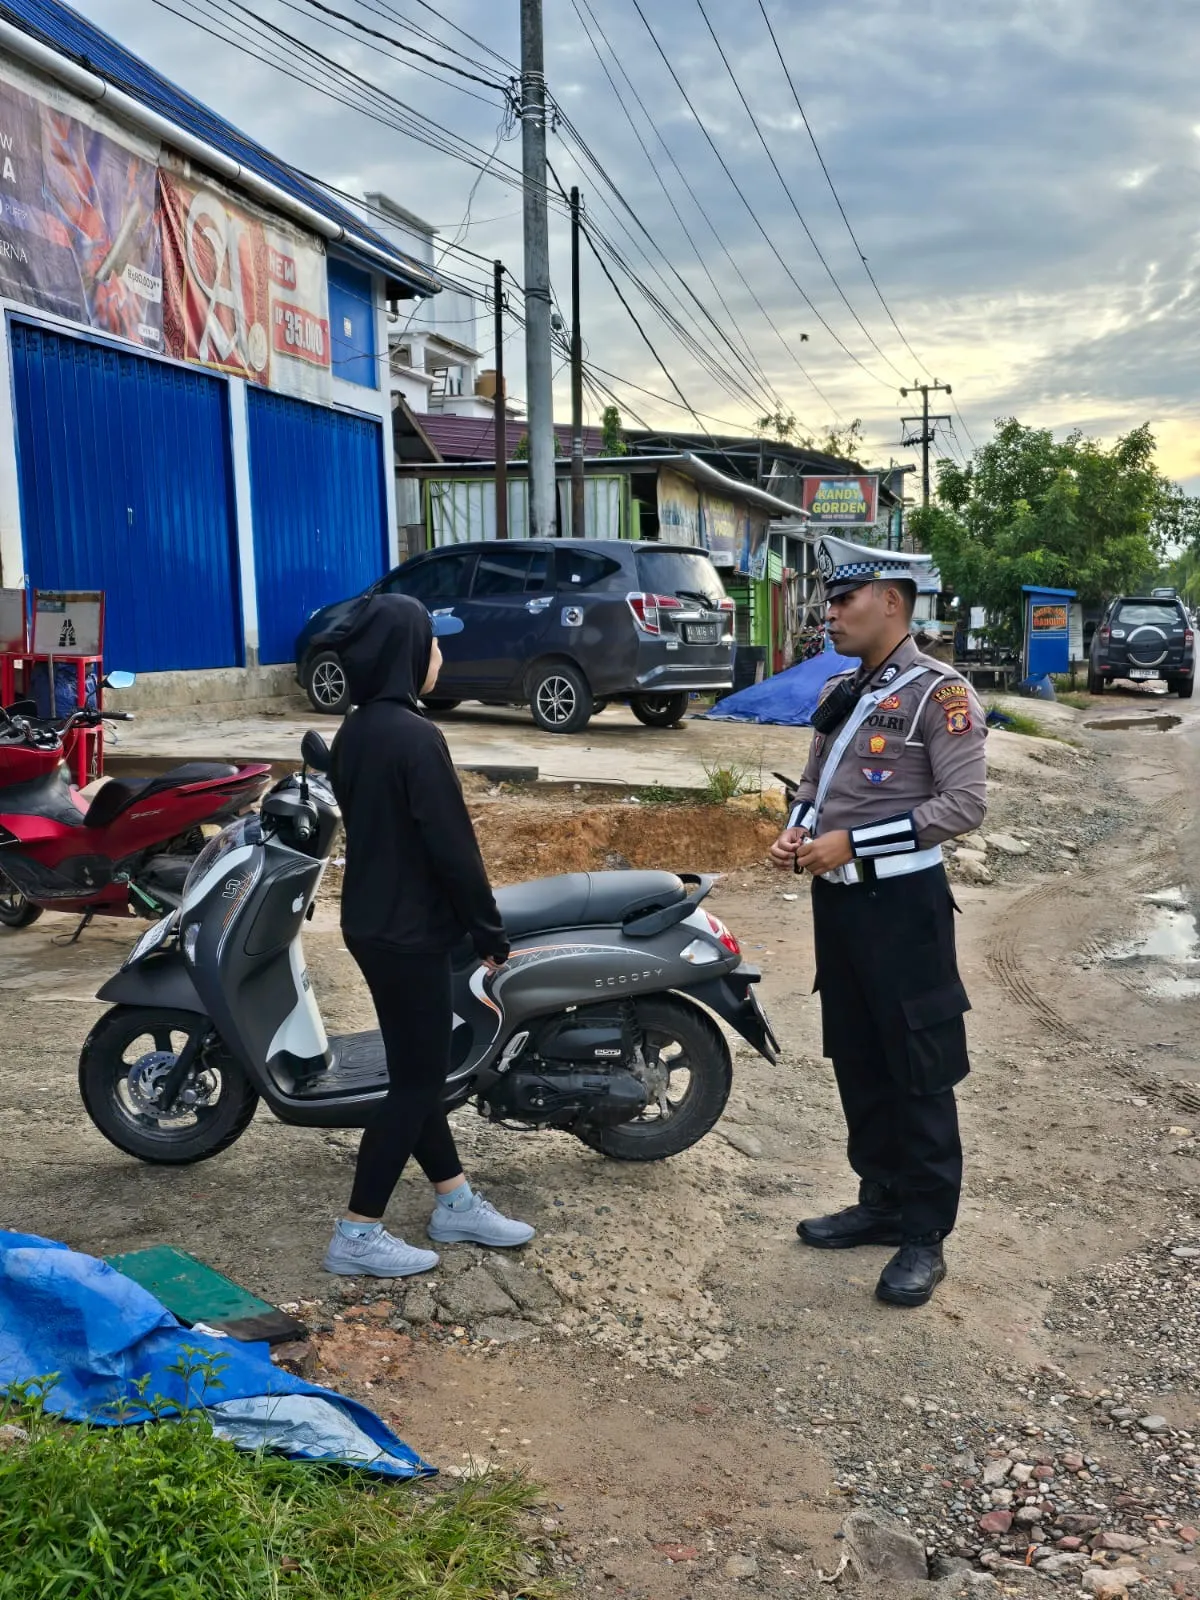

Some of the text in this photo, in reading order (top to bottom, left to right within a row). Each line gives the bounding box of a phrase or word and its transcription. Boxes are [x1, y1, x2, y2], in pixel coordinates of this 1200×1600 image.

[268, 251, 296, 284] NEW
[812, 502, 867, 514] GORDEN
[594, 968, 663, 988] SCOOPY
